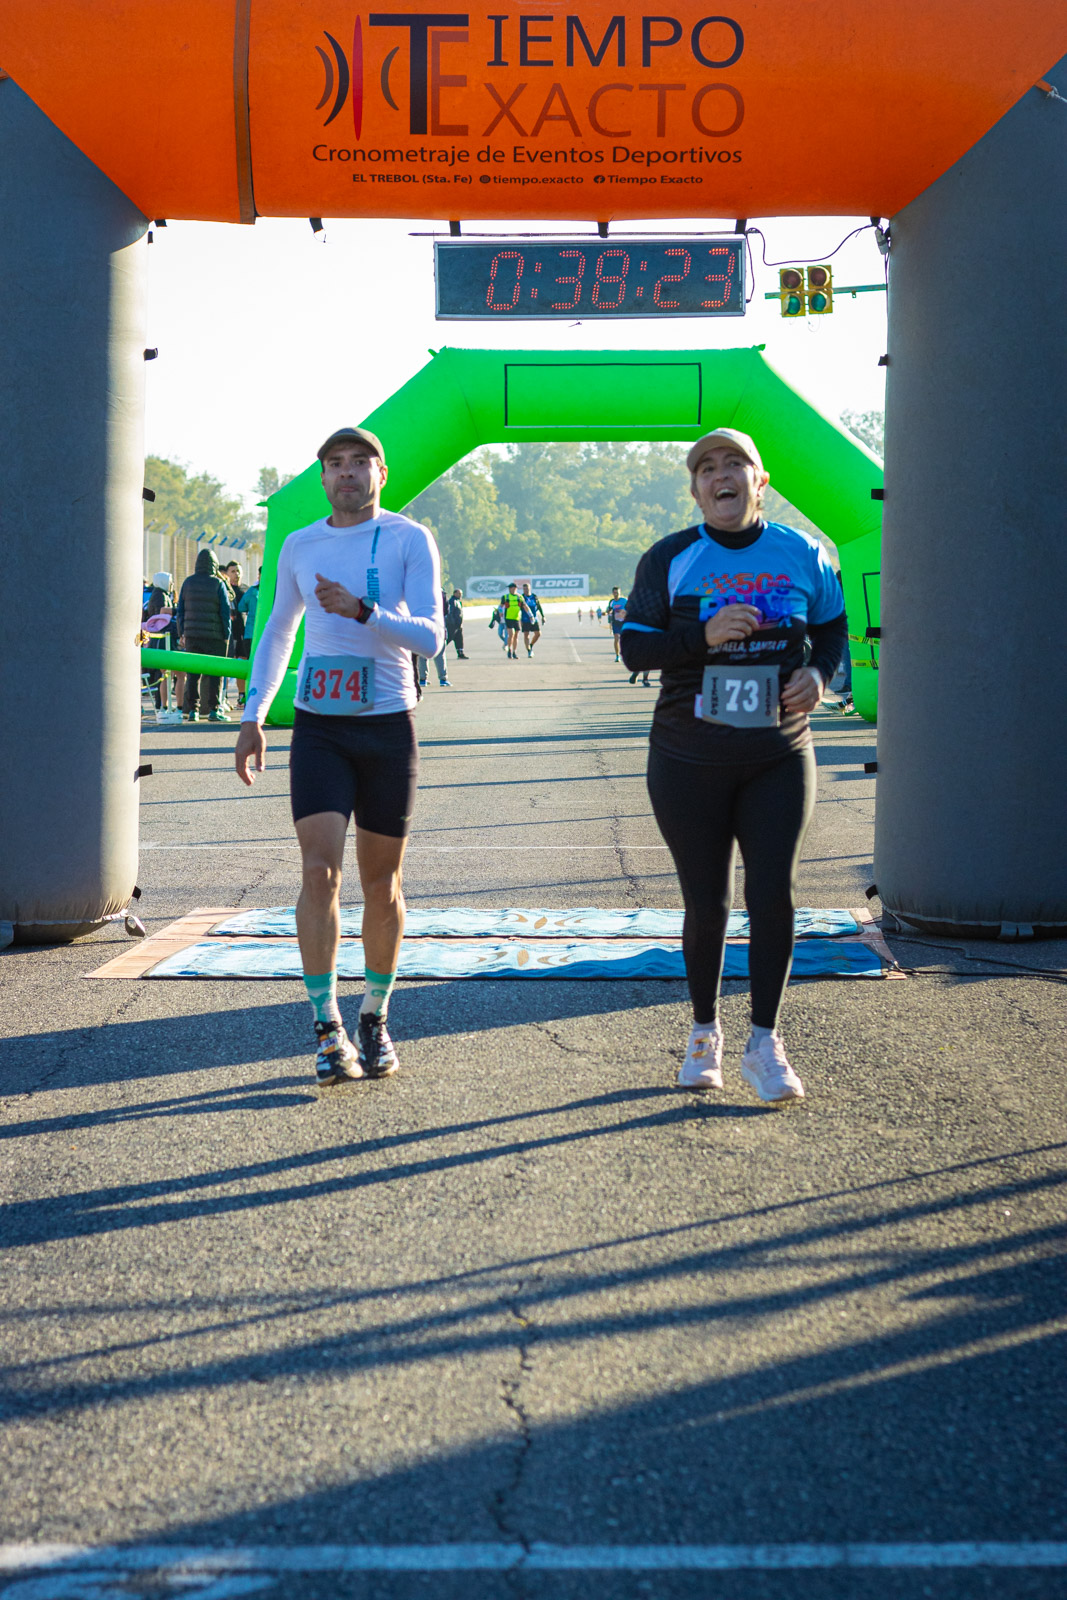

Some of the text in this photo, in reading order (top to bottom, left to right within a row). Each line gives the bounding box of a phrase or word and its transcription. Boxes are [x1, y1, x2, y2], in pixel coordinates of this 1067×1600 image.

[312, 144, 743, 167] Cronometraje de Eventos Deportivos
[352, 174, 473, 184] EL TREBOL (Sta. Fe)
[493, 175, 584, 186] tiempo.exacto
[607, 175, 703, 185] Tiempo Exacto
[486, 248, 735, 311] 0:38:23
[535, 579, 580, 588] LONG
[311, 669, 361, 702] 374
[725, 679, 759, 713] 73
